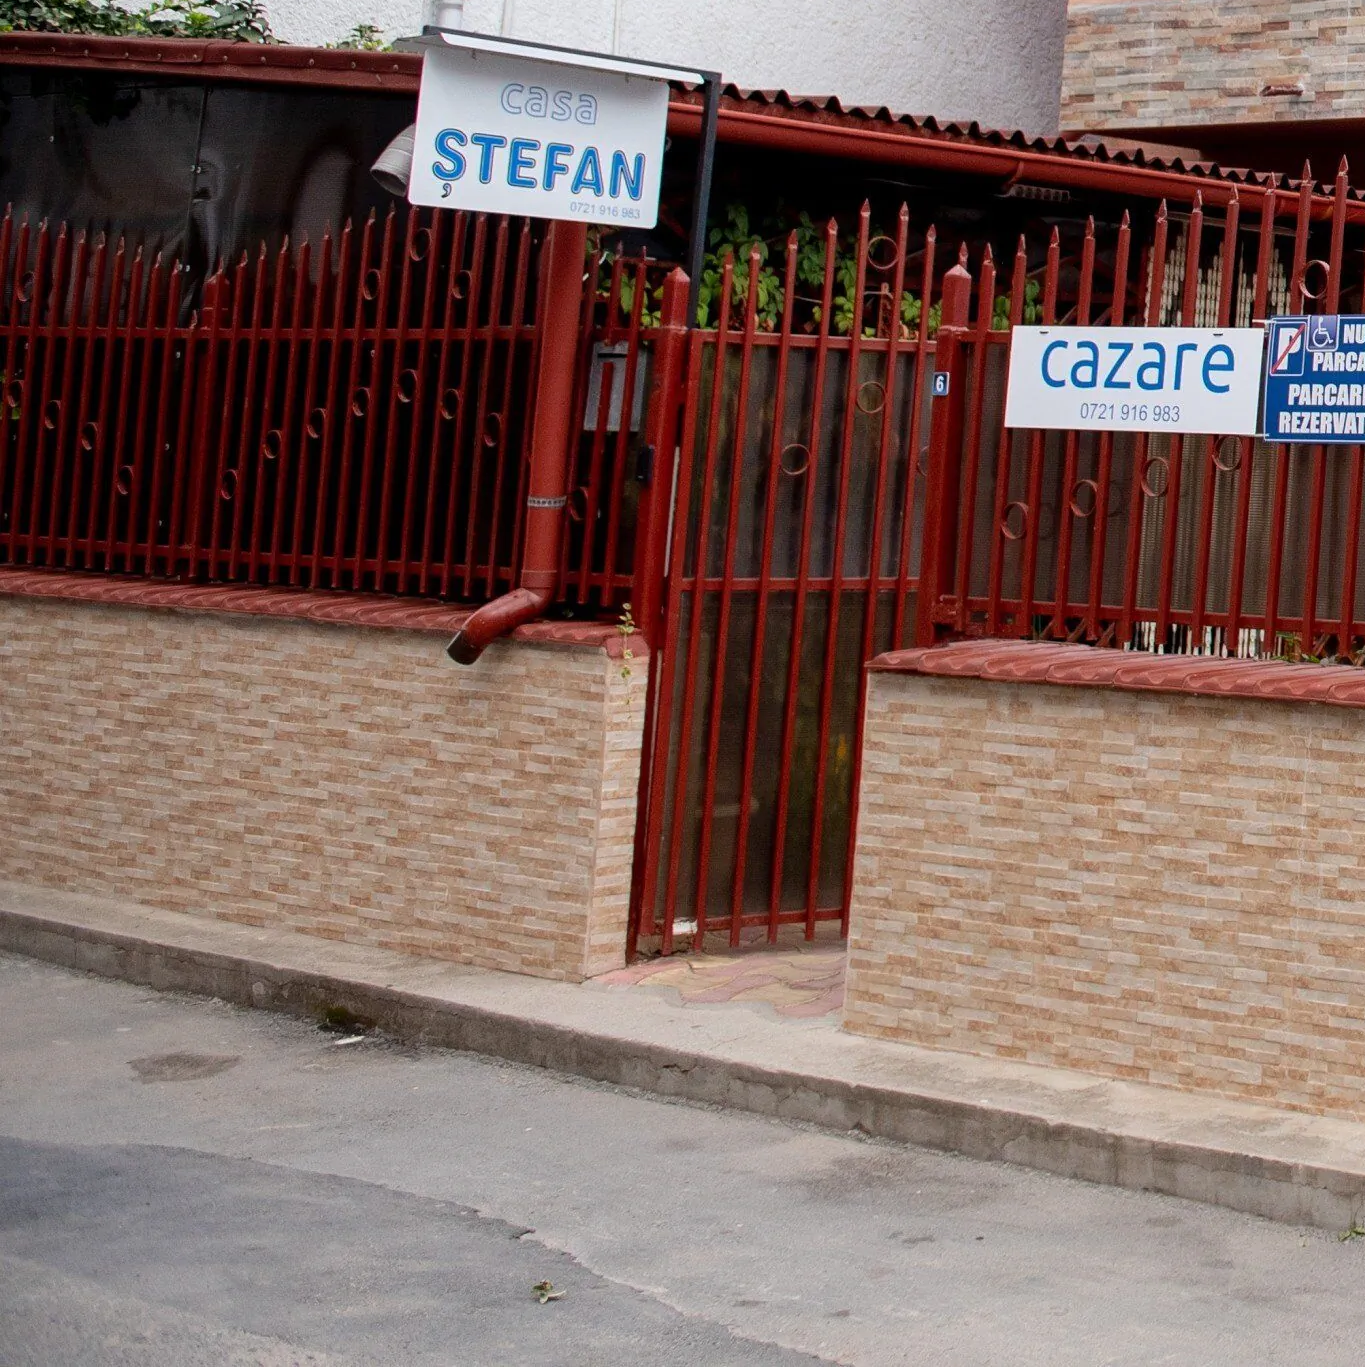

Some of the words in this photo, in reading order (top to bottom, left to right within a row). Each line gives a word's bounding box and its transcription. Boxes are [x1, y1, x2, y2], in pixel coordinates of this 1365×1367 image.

[501, 83, 598, 125] casa
[431, 128, 646, 201] ȘTEFAN
[570, 201, 595, 214] 0721
[1041, 339, 1235, 394] cazare
[936, 375, 945, 392] 6
[1079, 402, 1116, 421] 0721
[1120, 404, 1148, 422] 916
[1153, 405, 1180, 423] 983
